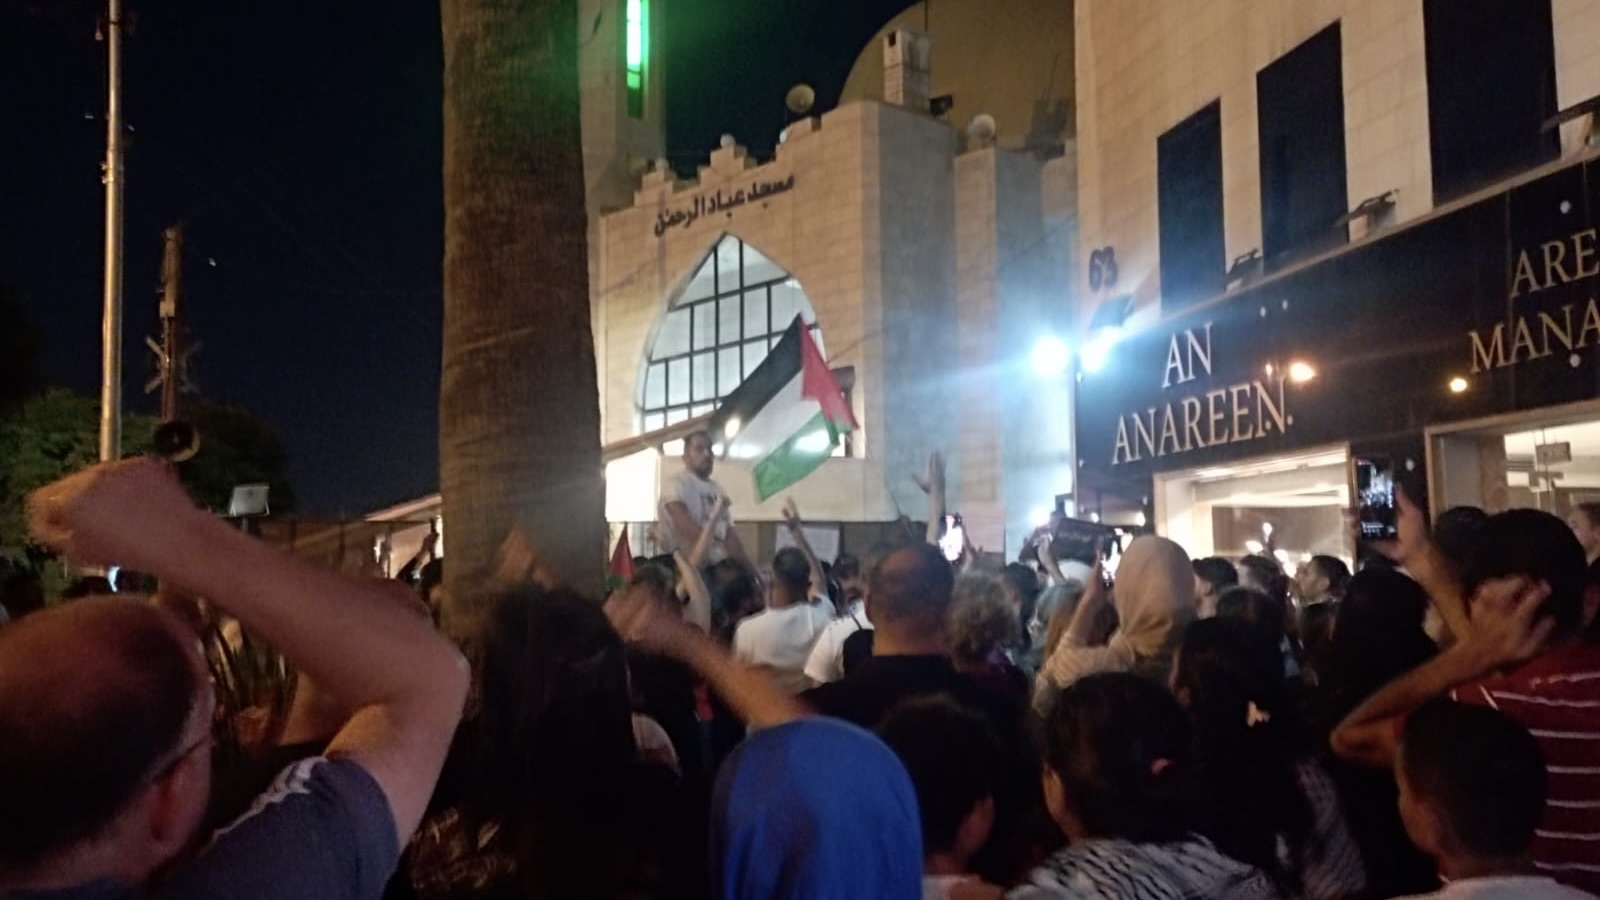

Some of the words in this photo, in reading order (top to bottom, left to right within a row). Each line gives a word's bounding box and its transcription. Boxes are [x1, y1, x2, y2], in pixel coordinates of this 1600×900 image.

[707, 188, 745, 219] عباد
[747, 174, 795, 209] مسجد
[655, 194, 705, 238] الرحمن
[1089, 245, 1118, 292] 63
[1162, 321, 1214, 389] AN
